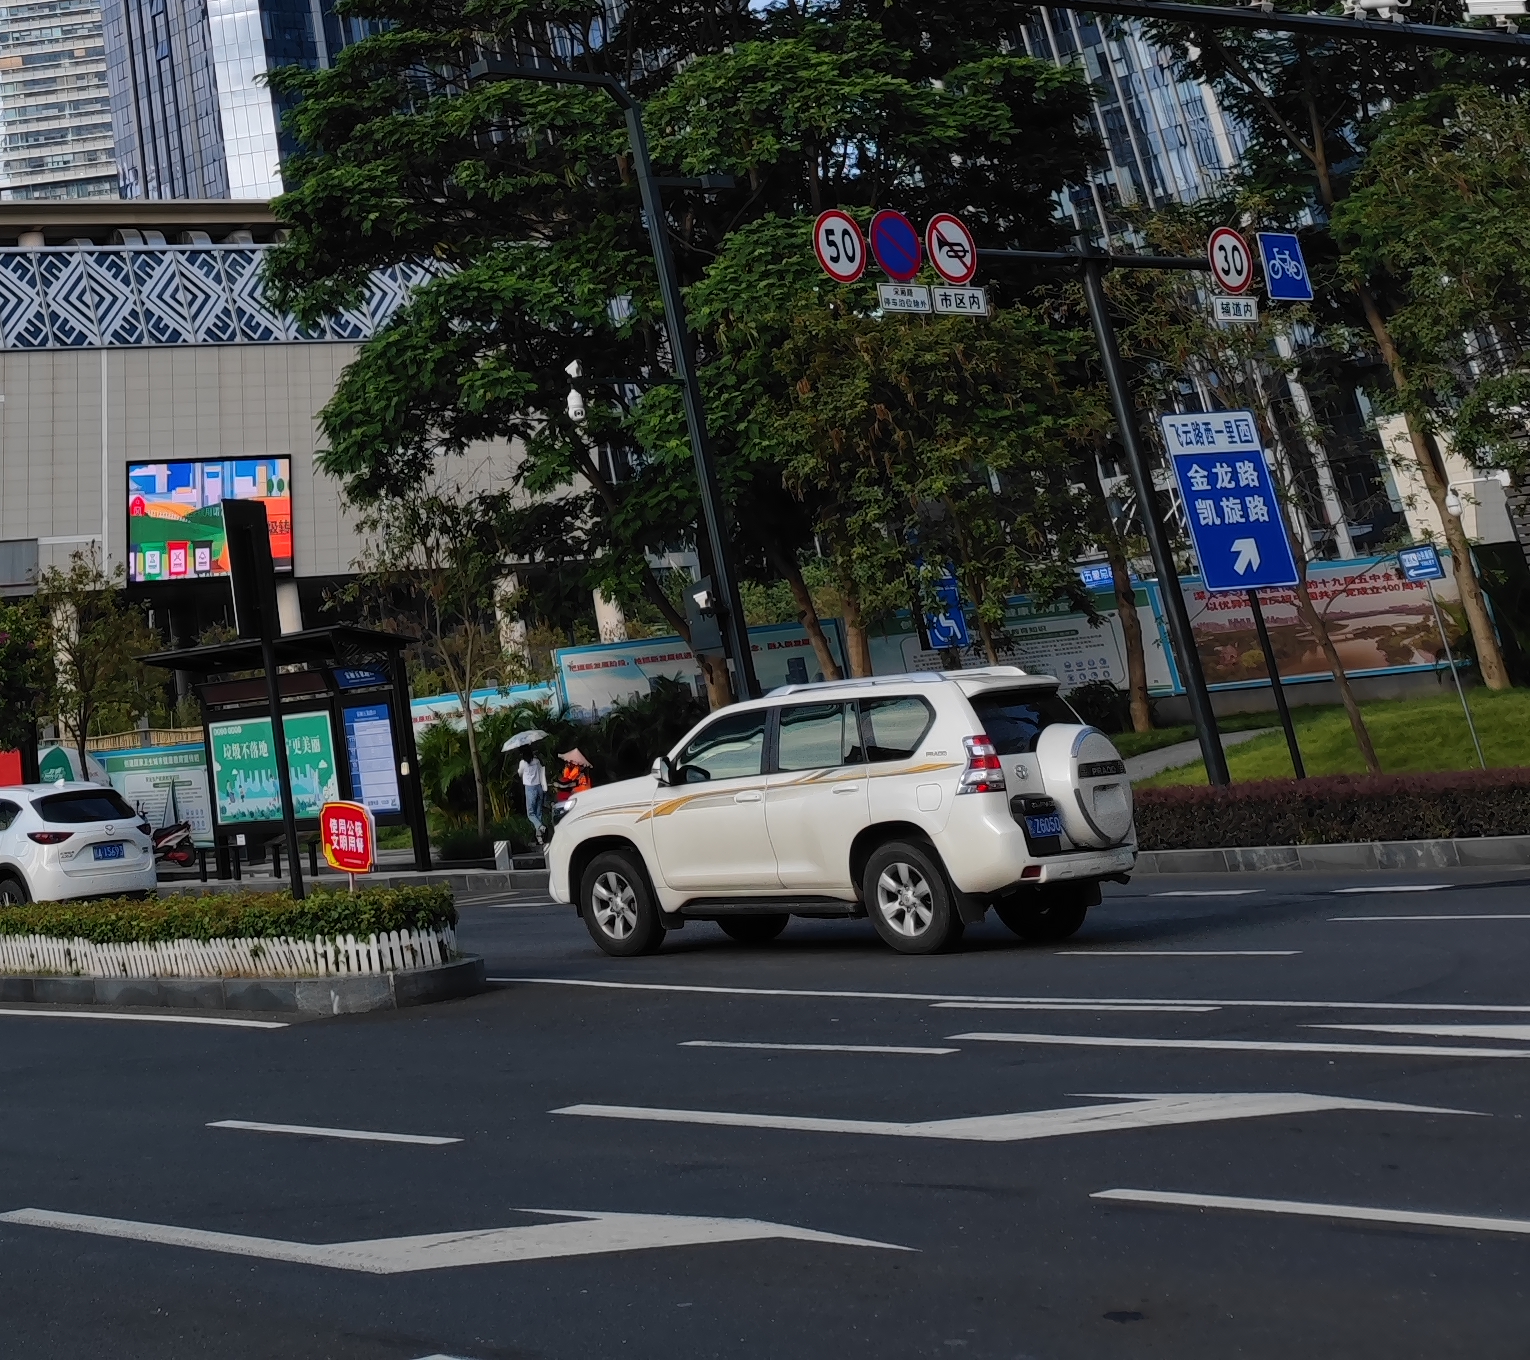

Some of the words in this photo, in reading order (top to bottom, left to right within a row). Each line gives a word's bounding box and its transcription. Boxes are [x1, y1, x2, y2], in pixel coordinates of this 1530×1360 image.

[824, 228, 856, 264] 50
[1218, 244, 1244, 277] 30
[938, 291, 982, 310] 市区内
[1220, 301, 1253, 317] 辅道内
[1187, 460, 1260, 491] 金龙路
[1194, 494, 1269, 526] 凯旋路
[222, 740, 269, 761] 垃圾不落地
[329, 817, 363, 837] 使用公筷
[330, 834, 365, 854] 文明用餐
